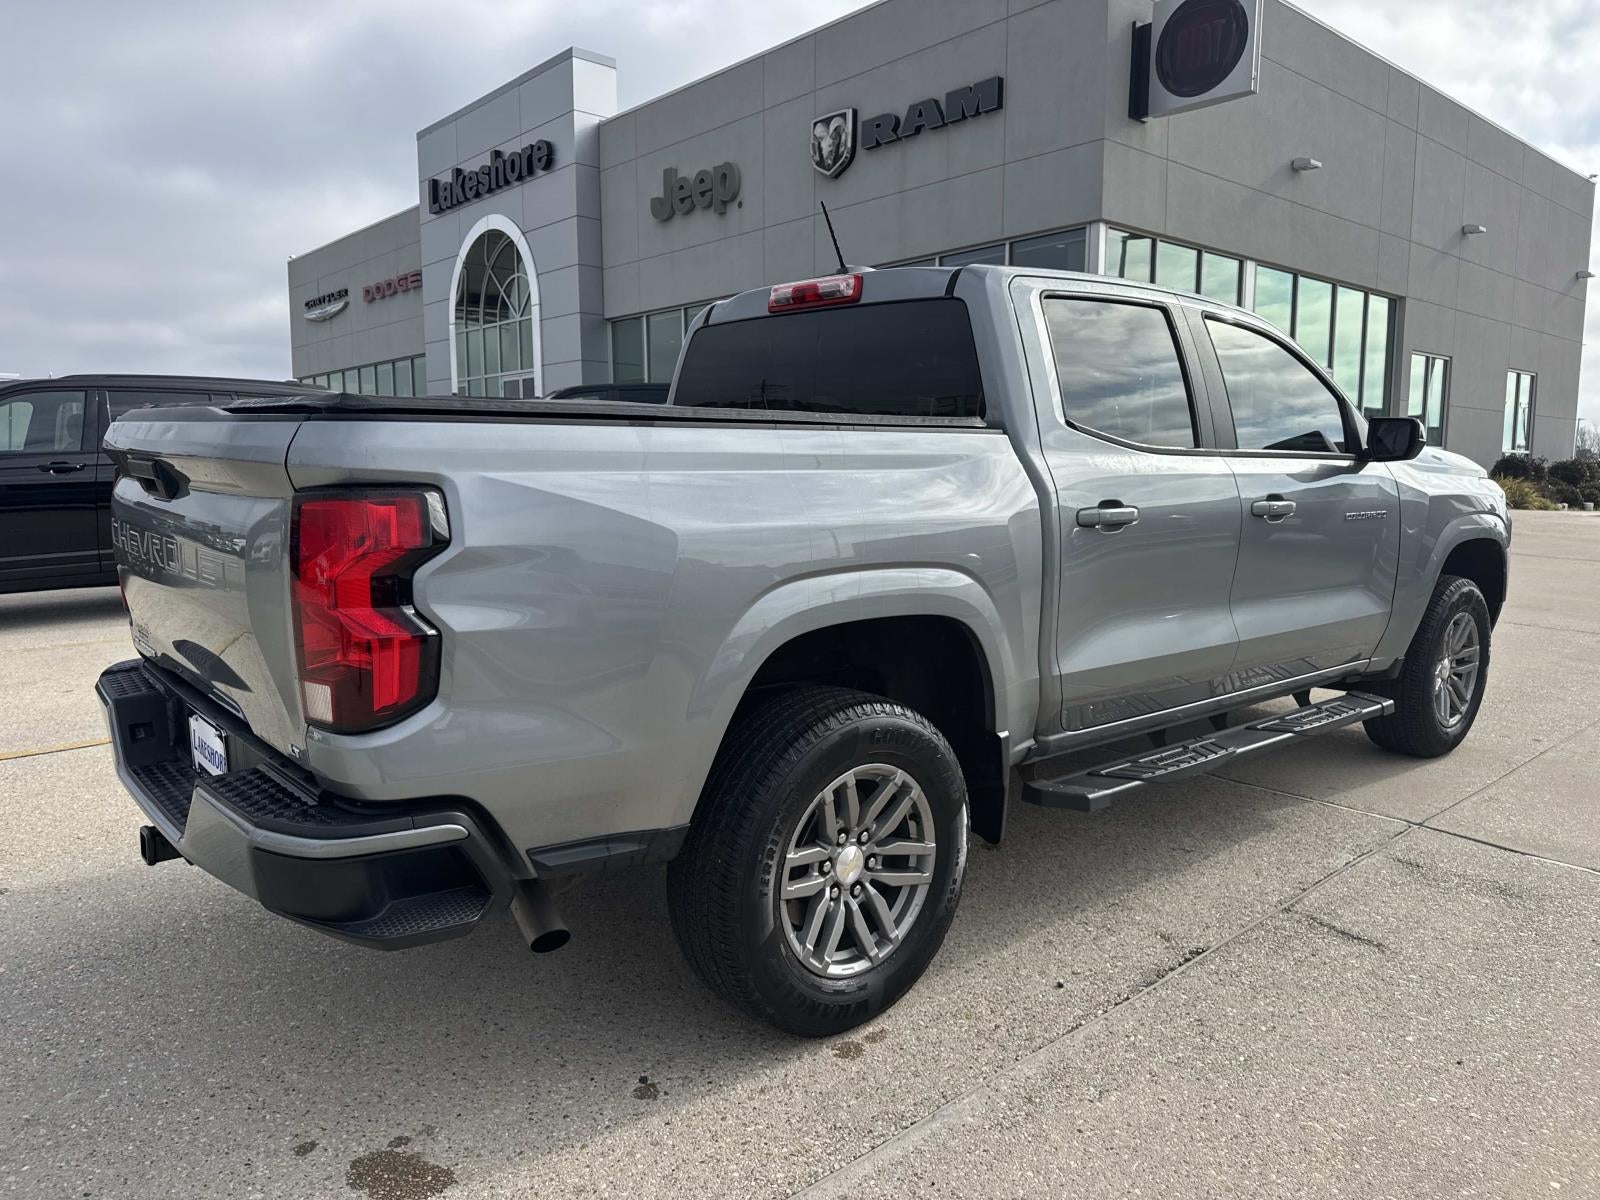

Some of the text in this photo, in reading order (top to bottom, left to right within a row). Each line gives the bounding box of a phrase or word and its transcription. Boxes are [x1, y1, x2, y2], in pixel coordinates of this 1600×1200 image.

[862, 76, 1003, 150] RAM
[428, 139, 553, 215] Lakeshore
[362, 269, 422, 303] DODGE
[112, 517, 241, 592] CHEVROLET
[193, 728, 226, 773] LAKESHOR
